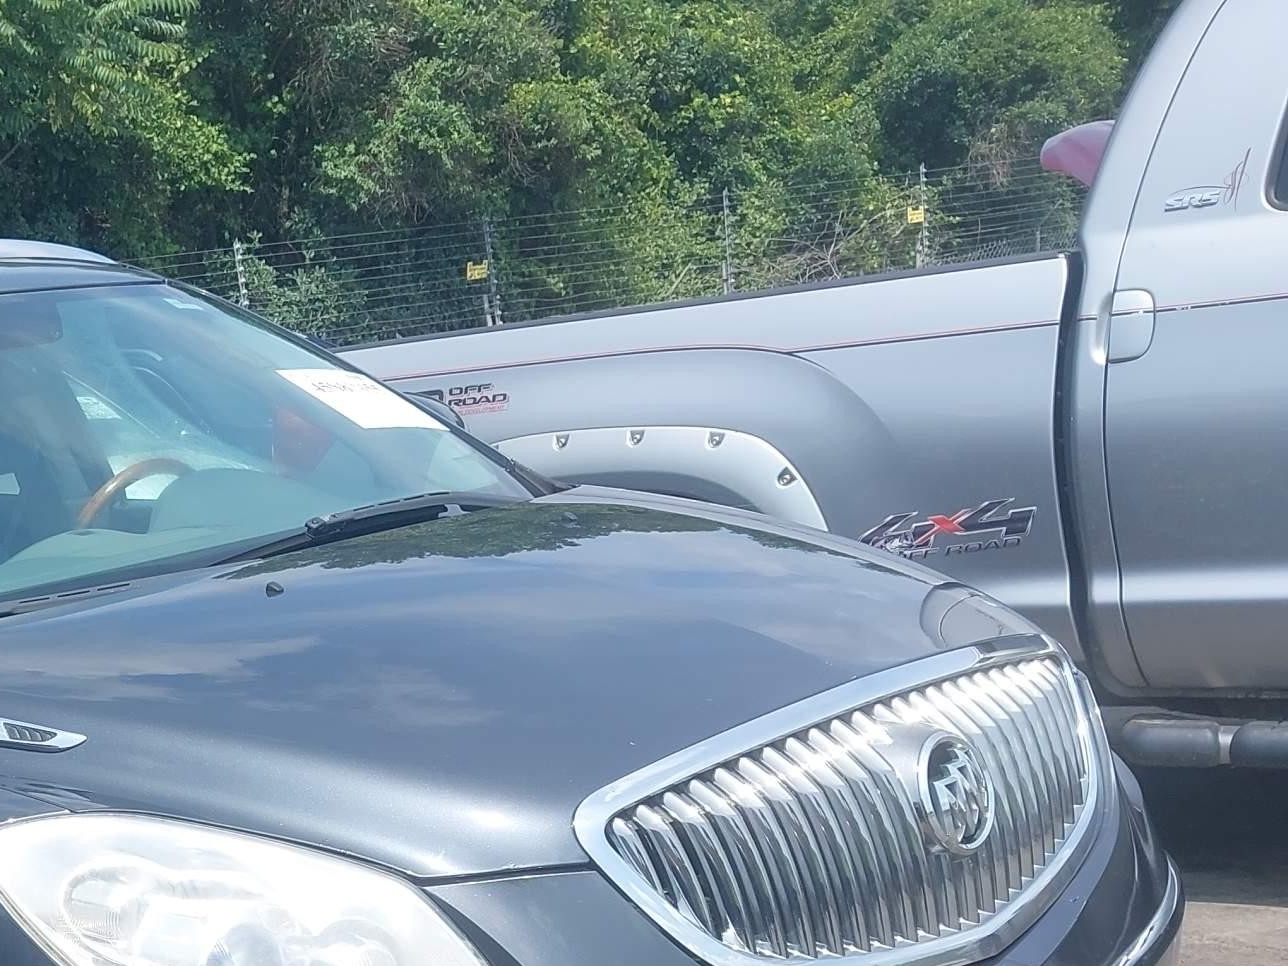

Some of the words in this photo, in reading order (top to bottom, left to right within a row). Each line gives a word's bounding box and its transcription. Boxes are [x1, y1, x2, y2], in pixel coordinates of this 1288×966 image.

[448, 382, 493, 396] OFF
[447, 393, 508, 407] ROAD
[944, 536, 1023, 556] ROAD
